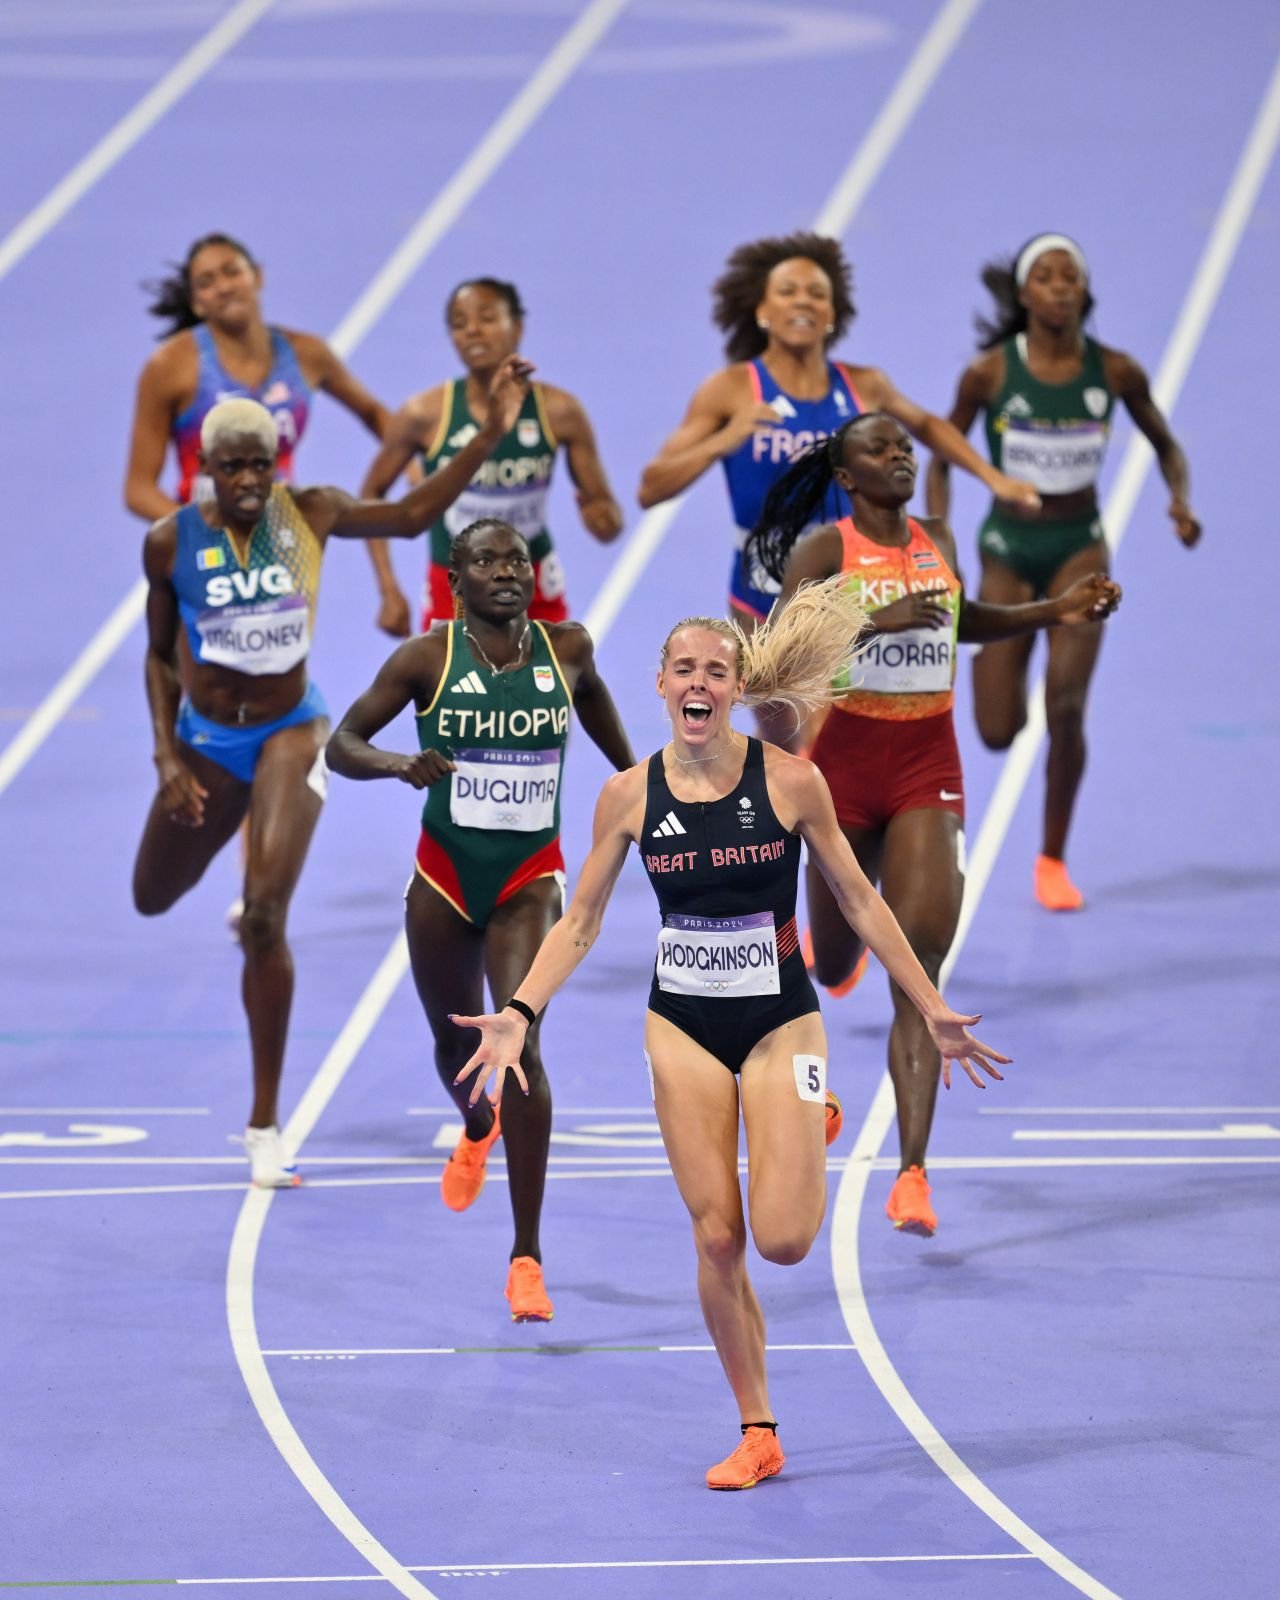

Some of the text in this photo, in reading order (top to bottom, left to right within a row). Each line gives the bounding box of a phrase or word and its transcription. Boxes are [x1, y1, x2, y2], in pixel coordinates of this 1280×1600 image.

[205, 564, 295, 608] SVG
[205, 622, 304, 653] MALONEY
[857, 641, 949, 668] MORAA
[437, 705, 569, 739] ETHIOPIA
[483, 751, 513, 763] PARIS
[456, 776, 556, 805] DUGUMA
[645, 838, 785, 873] GREAT BRITAIN
[683, 919, 744, 929] PARIS 2024
[661, 941, 775, 971] HODGKINSON
[807, 1064, 820, 1093] 5
